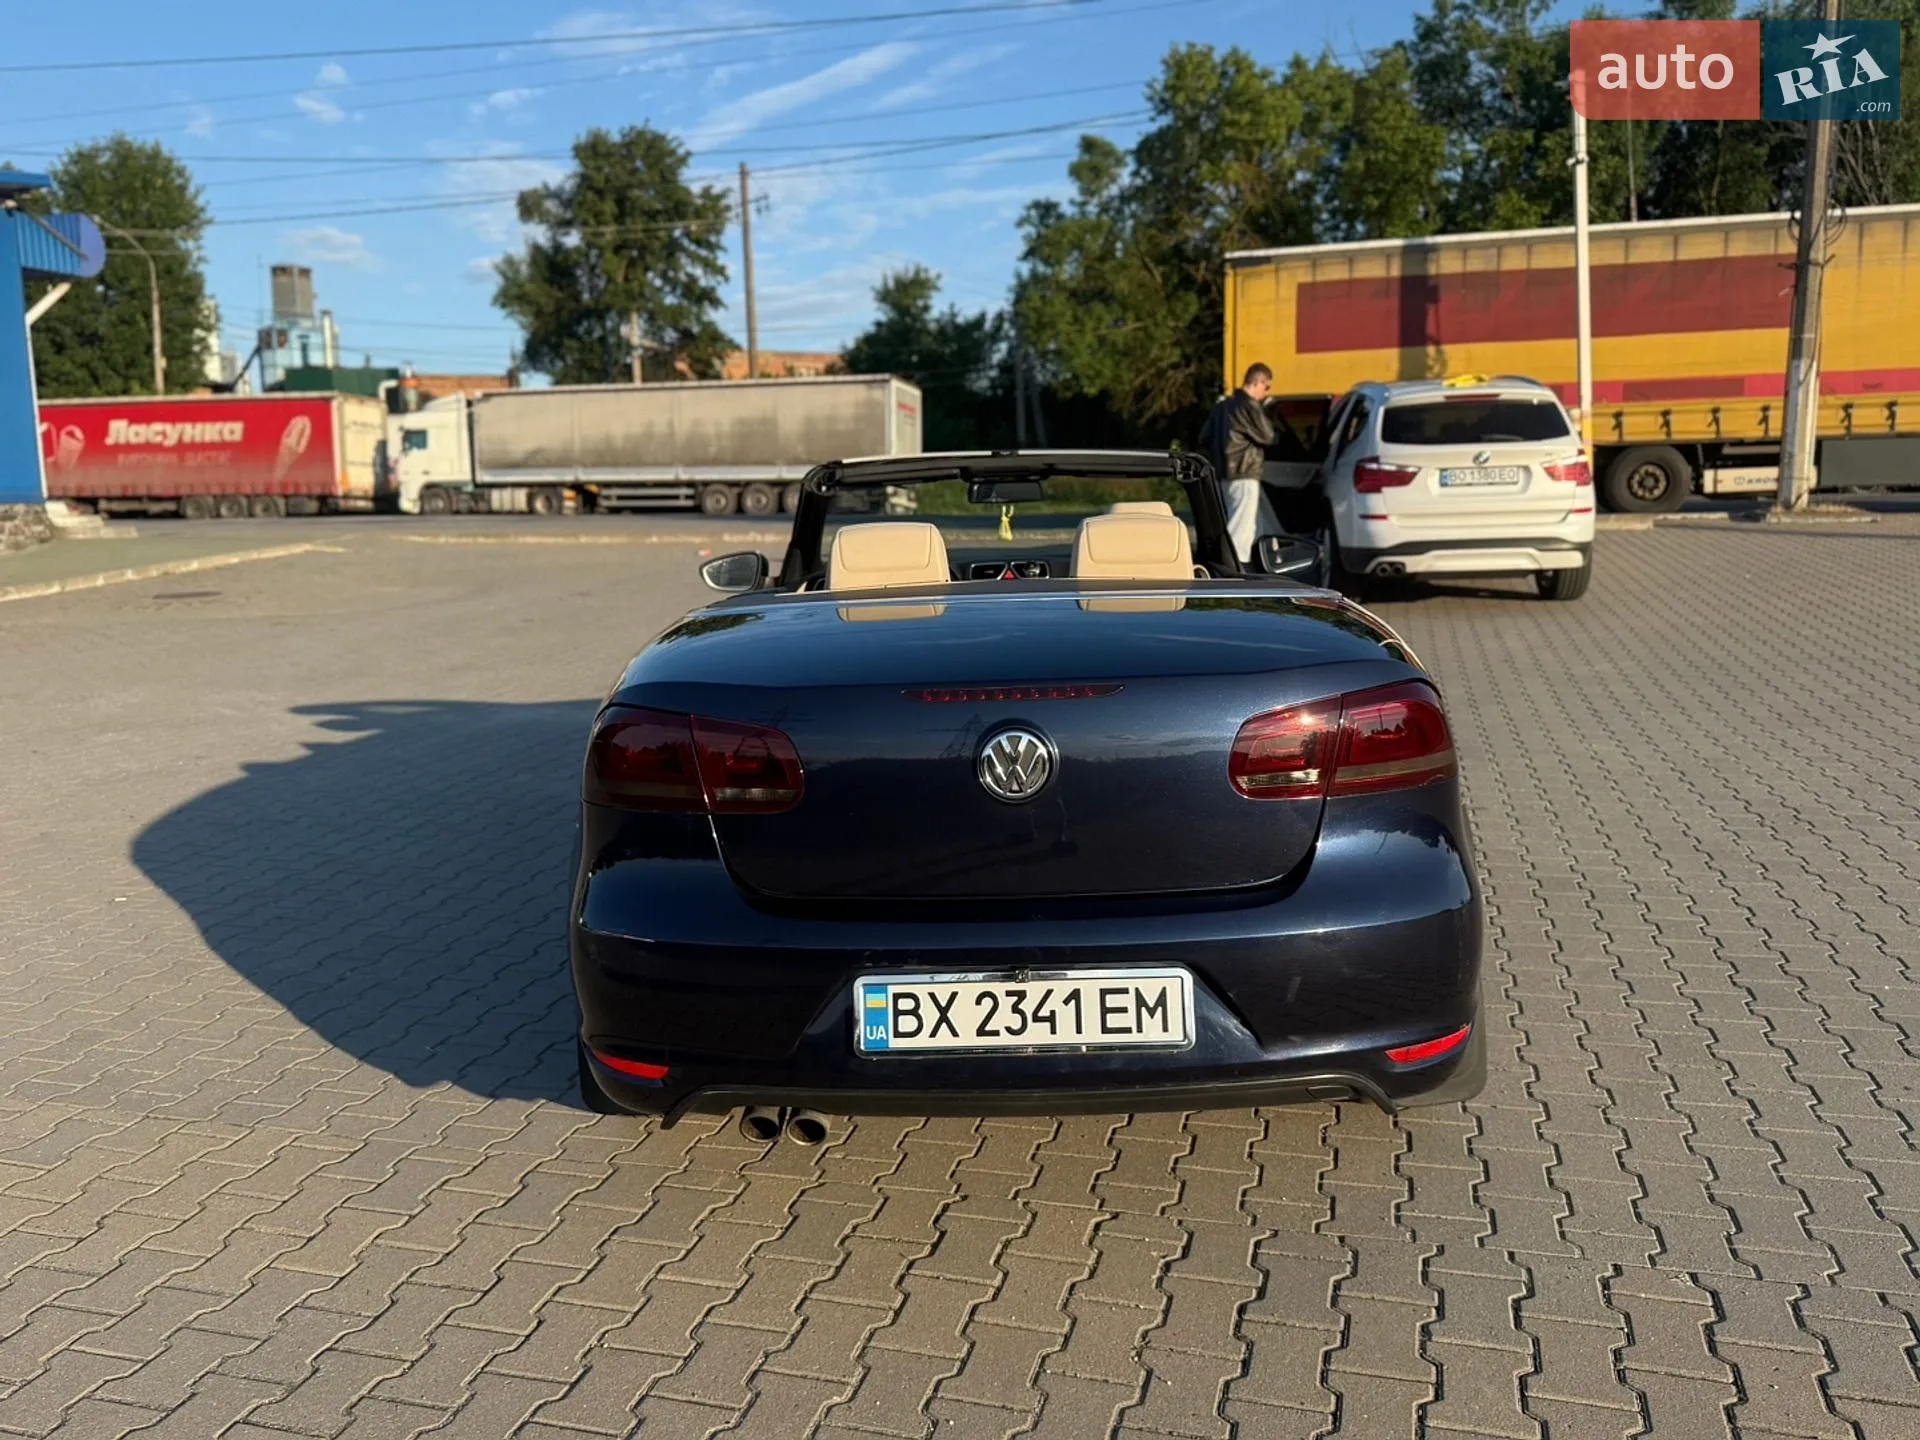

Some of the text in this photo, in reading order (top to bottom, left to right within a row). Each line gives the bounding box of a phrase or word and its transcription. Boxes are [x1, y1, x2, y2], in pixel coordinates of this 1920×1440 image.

[104, 418, 245, 447] Ласунка
[892, 985, 1170, 1039] BX 2341 EM
[866, 1025, 887, 1041] UA
